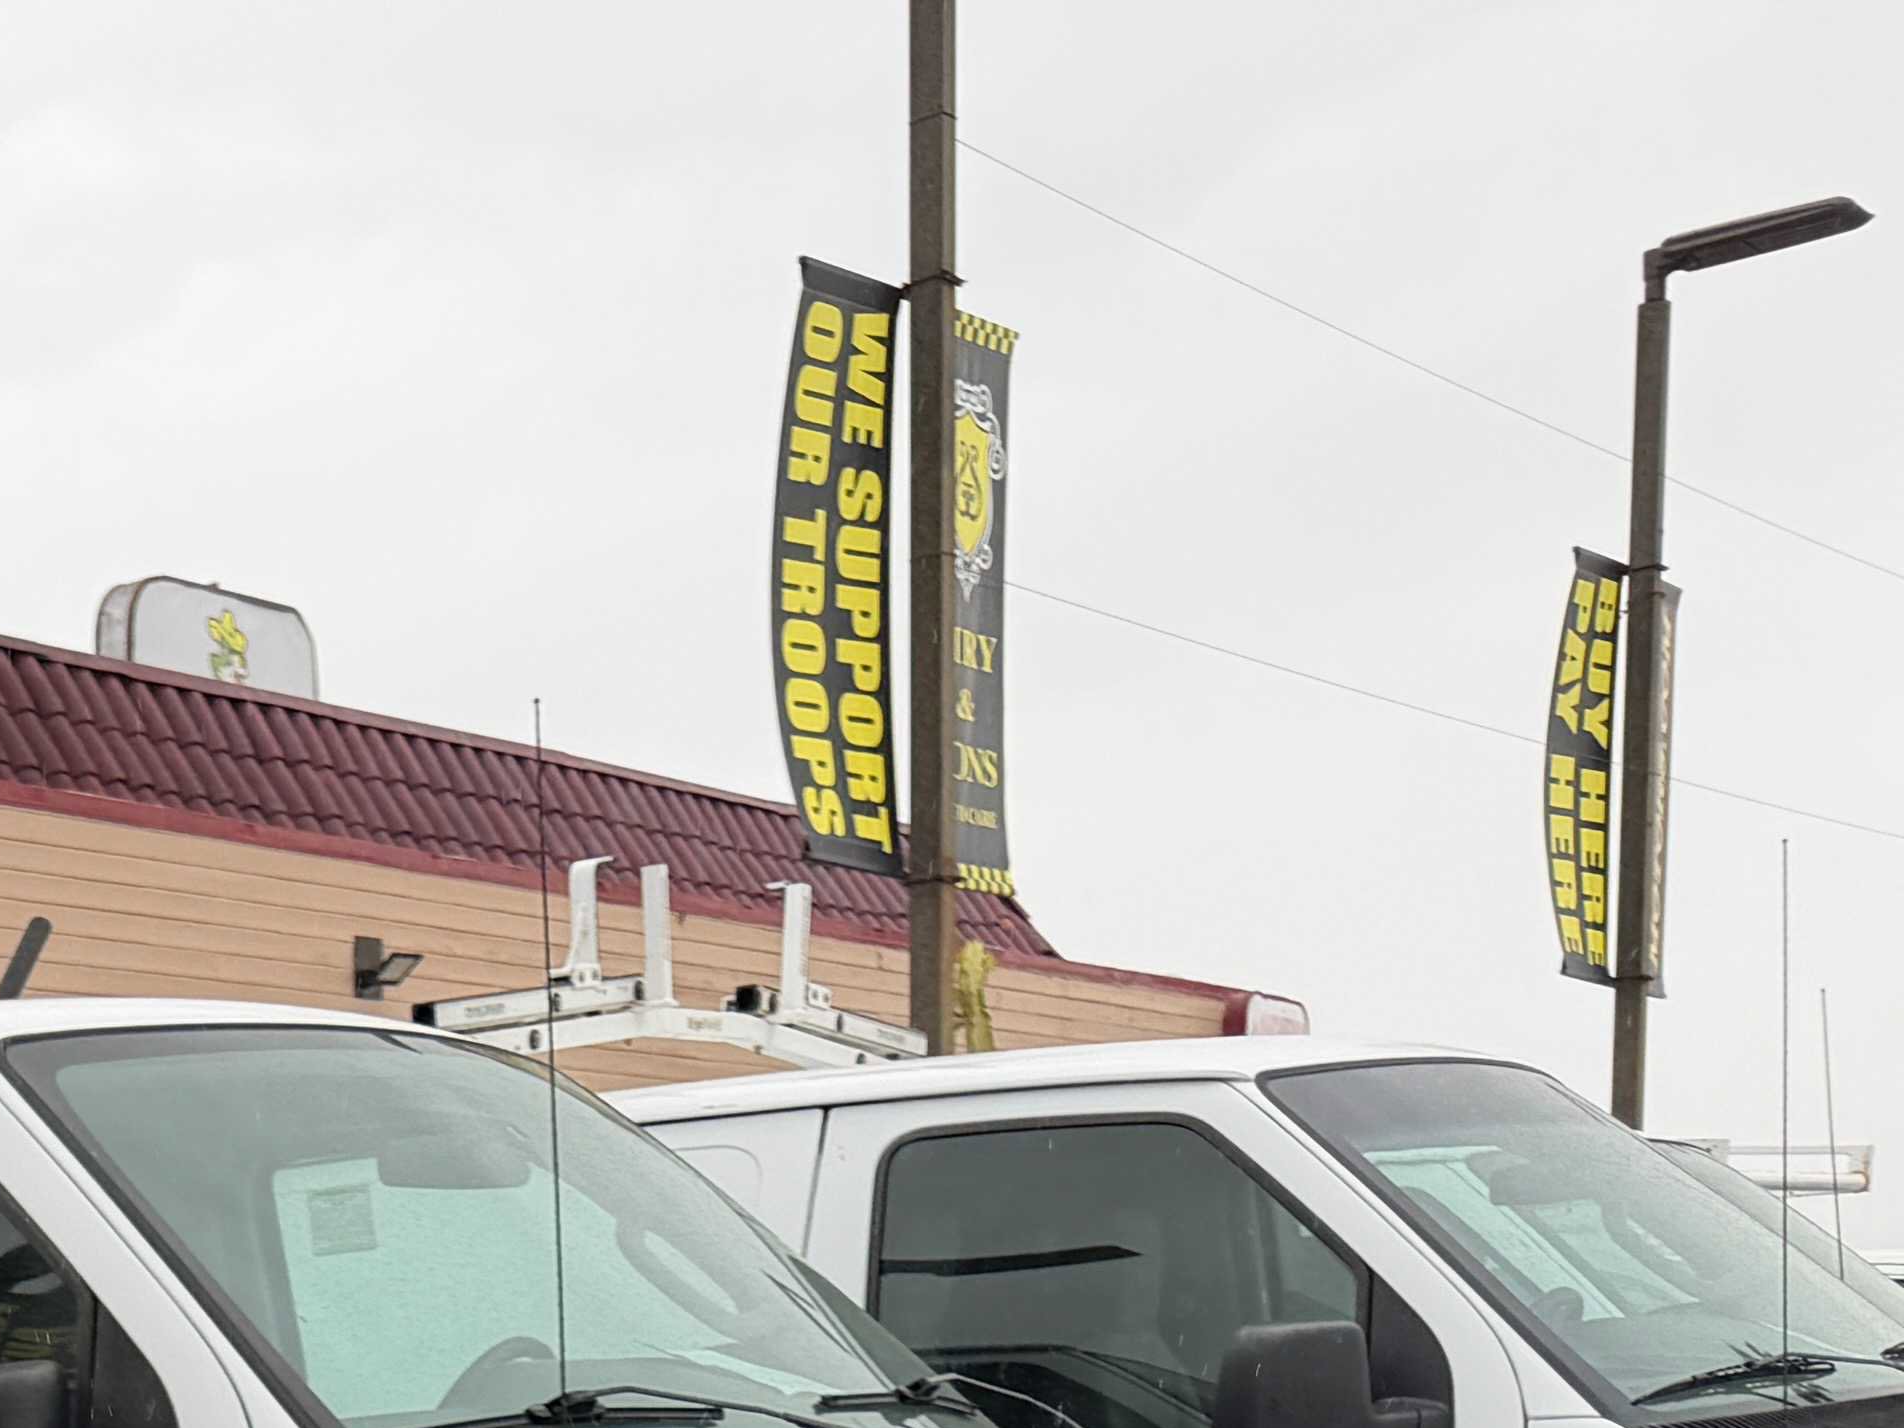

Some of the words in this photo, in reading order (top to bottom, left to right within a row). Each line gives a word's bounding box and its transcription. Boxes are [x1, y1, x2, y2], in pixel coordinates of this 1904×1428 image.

[785, 300, 845, 487] OUR
[847, 310, 891, 449] WE
[780, 508, 847, 839] TROOPS
[835, 466, 893, 855] SUPPORT
[952, 627, 998, 673] IRY
[955, 687, 976, 722] &
[1555, 577, 1596, 736] PAY
[1581, 576, 1619, 751] BUY
[1549, 753, 1585, 955] HERE
[1578, 767, 1608, 967] HERE
